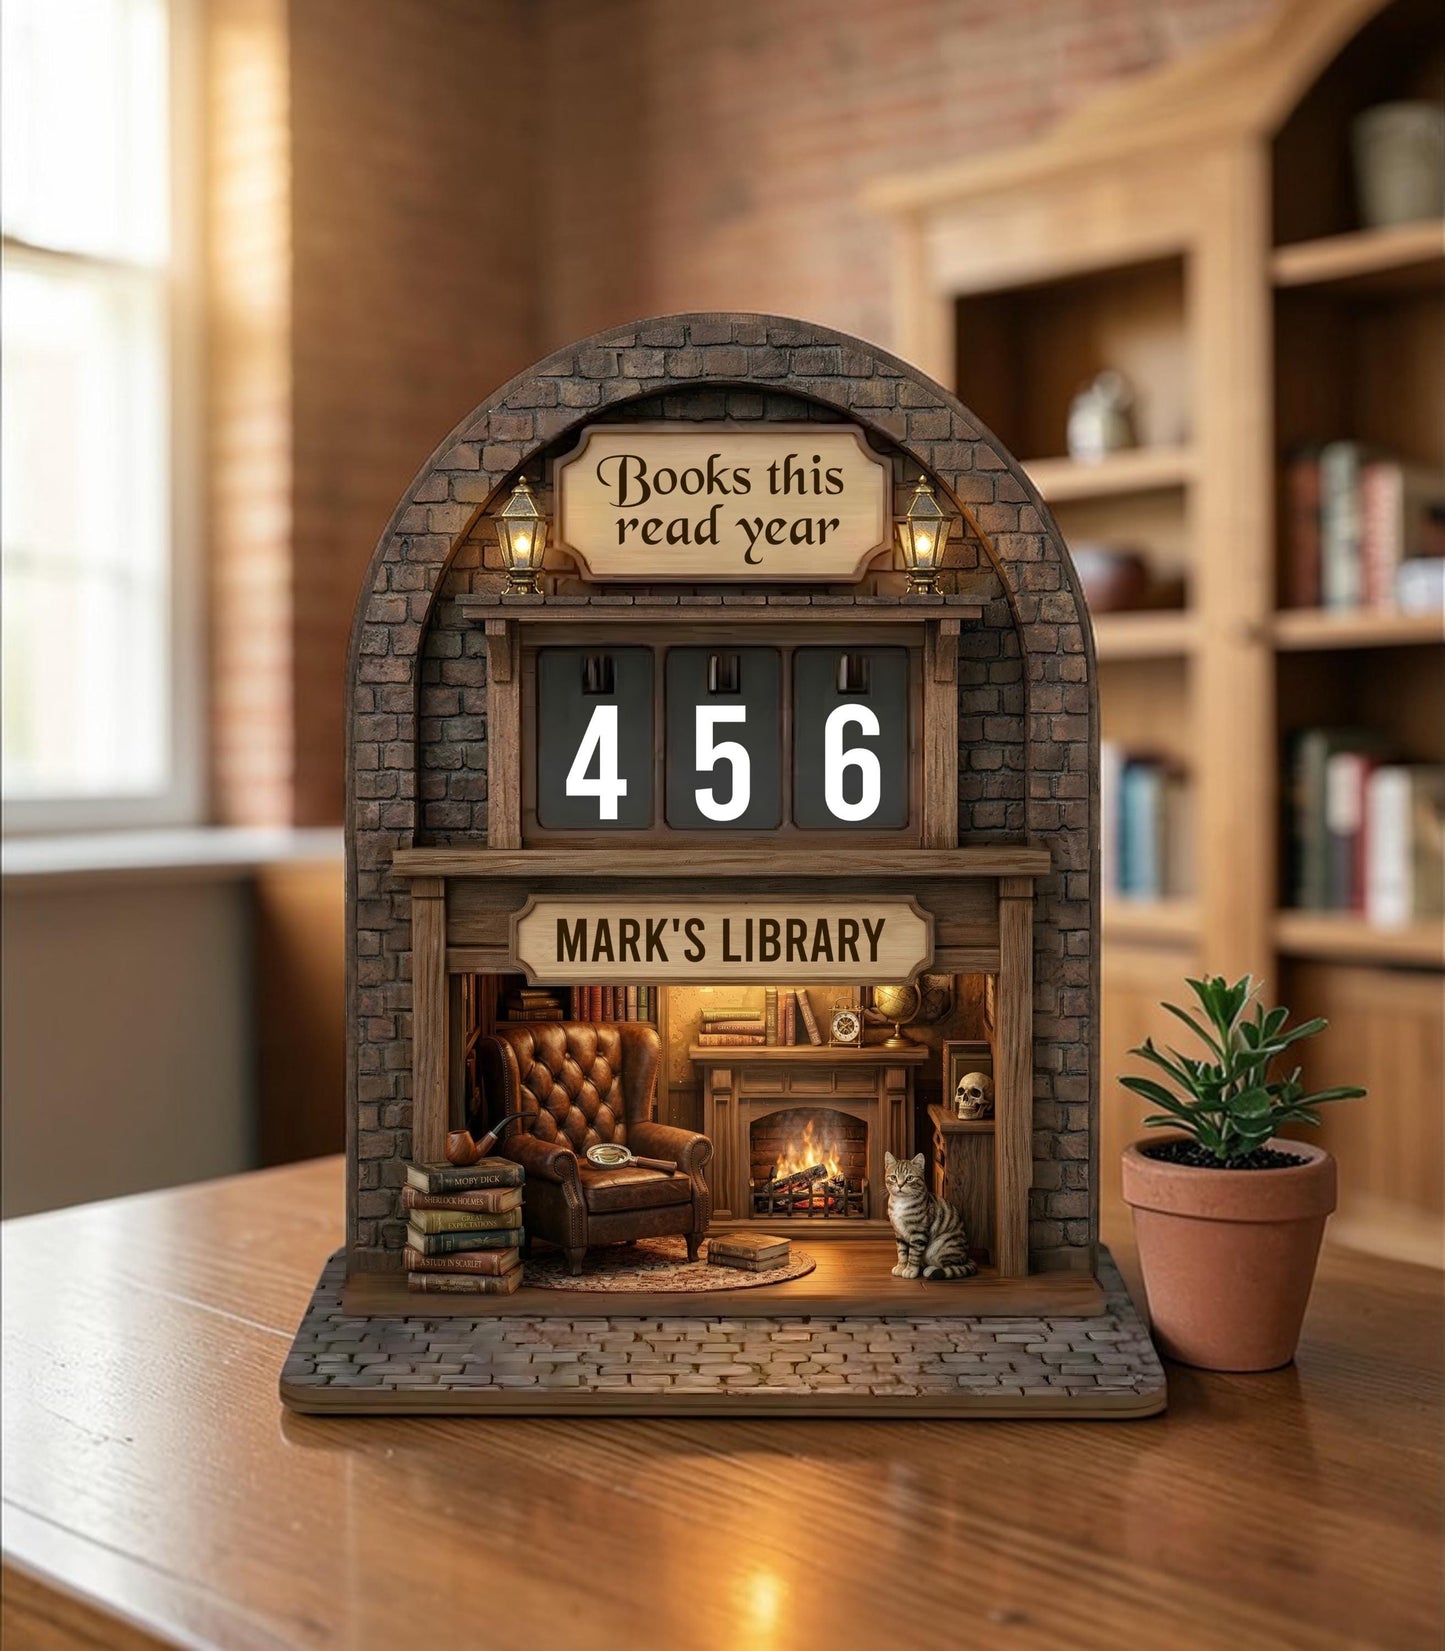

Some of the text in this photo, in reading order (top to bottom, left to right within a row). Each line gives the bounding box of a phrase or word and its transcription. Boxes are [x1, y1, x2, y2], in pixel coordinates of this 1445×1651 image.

[597, 454, 844, 508] Books this
[615, 504, 840, 565] read year
[566, 704, 881, 822] 4 5 6
[556, 918, 886, 963] MARK'S LIBRARY
[454, 1176, 479, 1185] MOBY
[480, 1175, 500, 1183] DICK
[424, 1196, 484, 1206] SHERLOCK HOLMES
[448, 1219, 497, 1229] EXPECTATIONS
[426, 1259, 446, 1267] STUDY
[447, 1259, 456, 1267] IN
[455, 1260, 482, 1269] SCARLET
